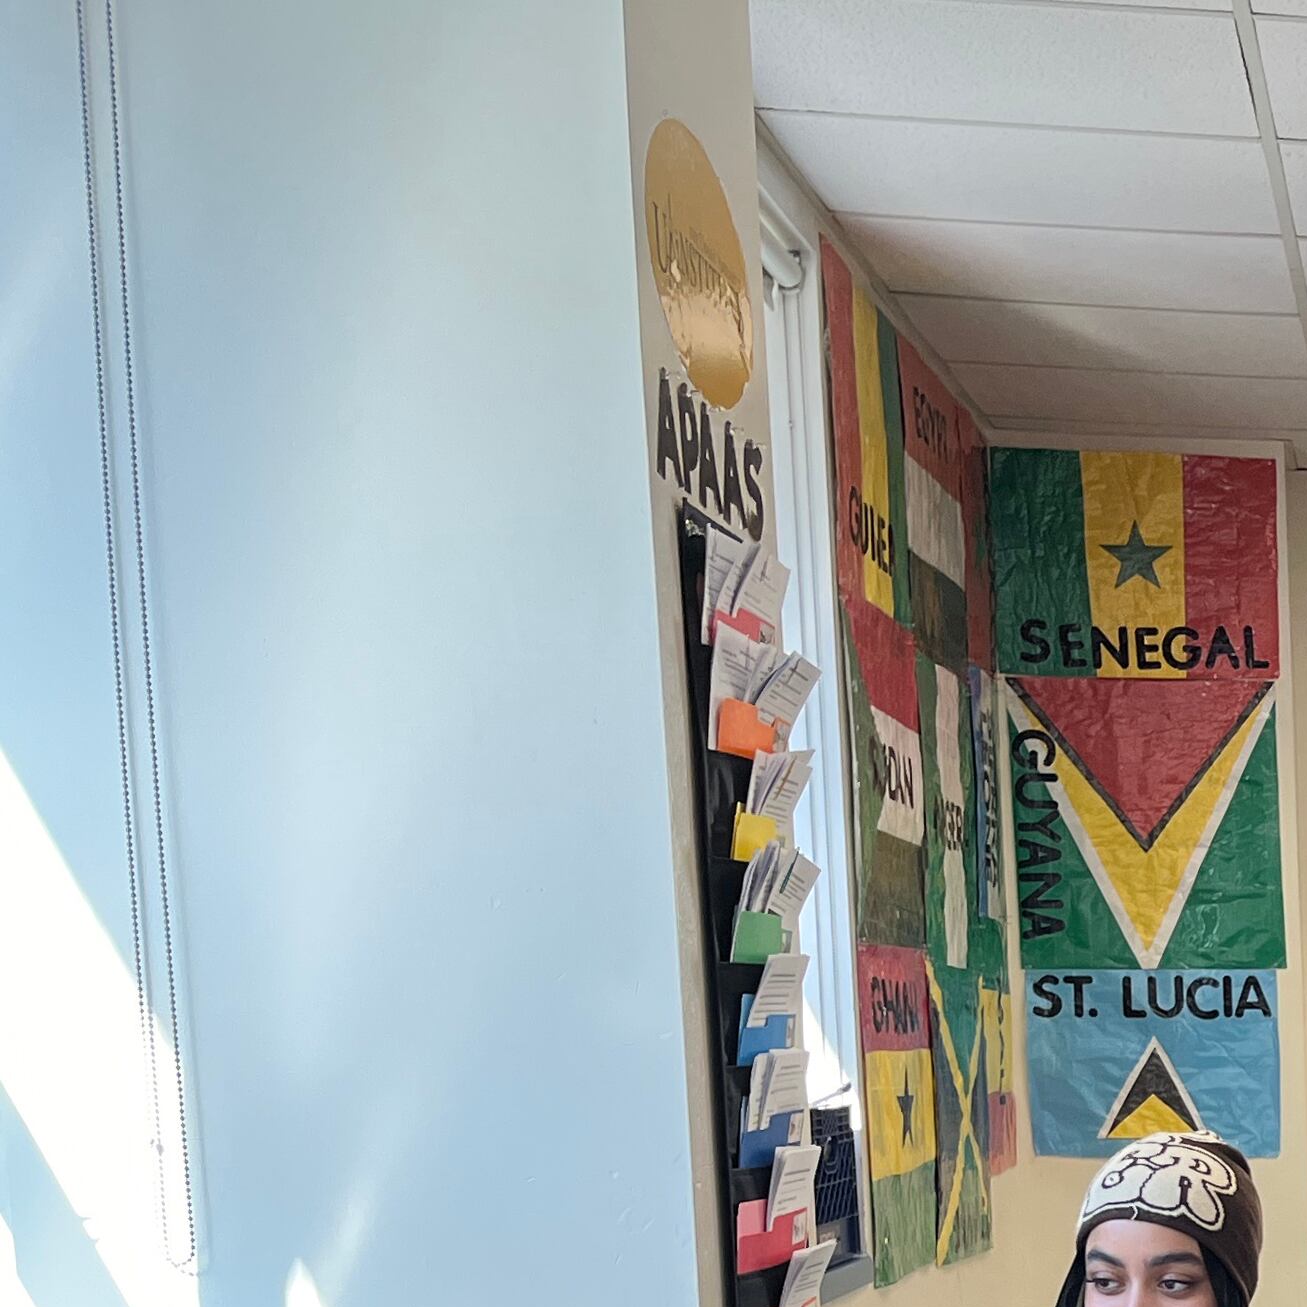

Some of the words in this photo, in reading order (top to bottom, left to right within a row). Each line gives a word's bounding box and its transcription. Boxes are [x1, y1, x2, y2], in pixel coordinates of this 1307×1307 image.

[657, 367, 764, 542] APAAS
[1020, 619, 1270, 670] SENEGAL
[1012, 729, 1065, 940] GUYANA
[1032, 975, 1098, 1018] ST.
[1122, 975, 1272, 1020] LUCIA
